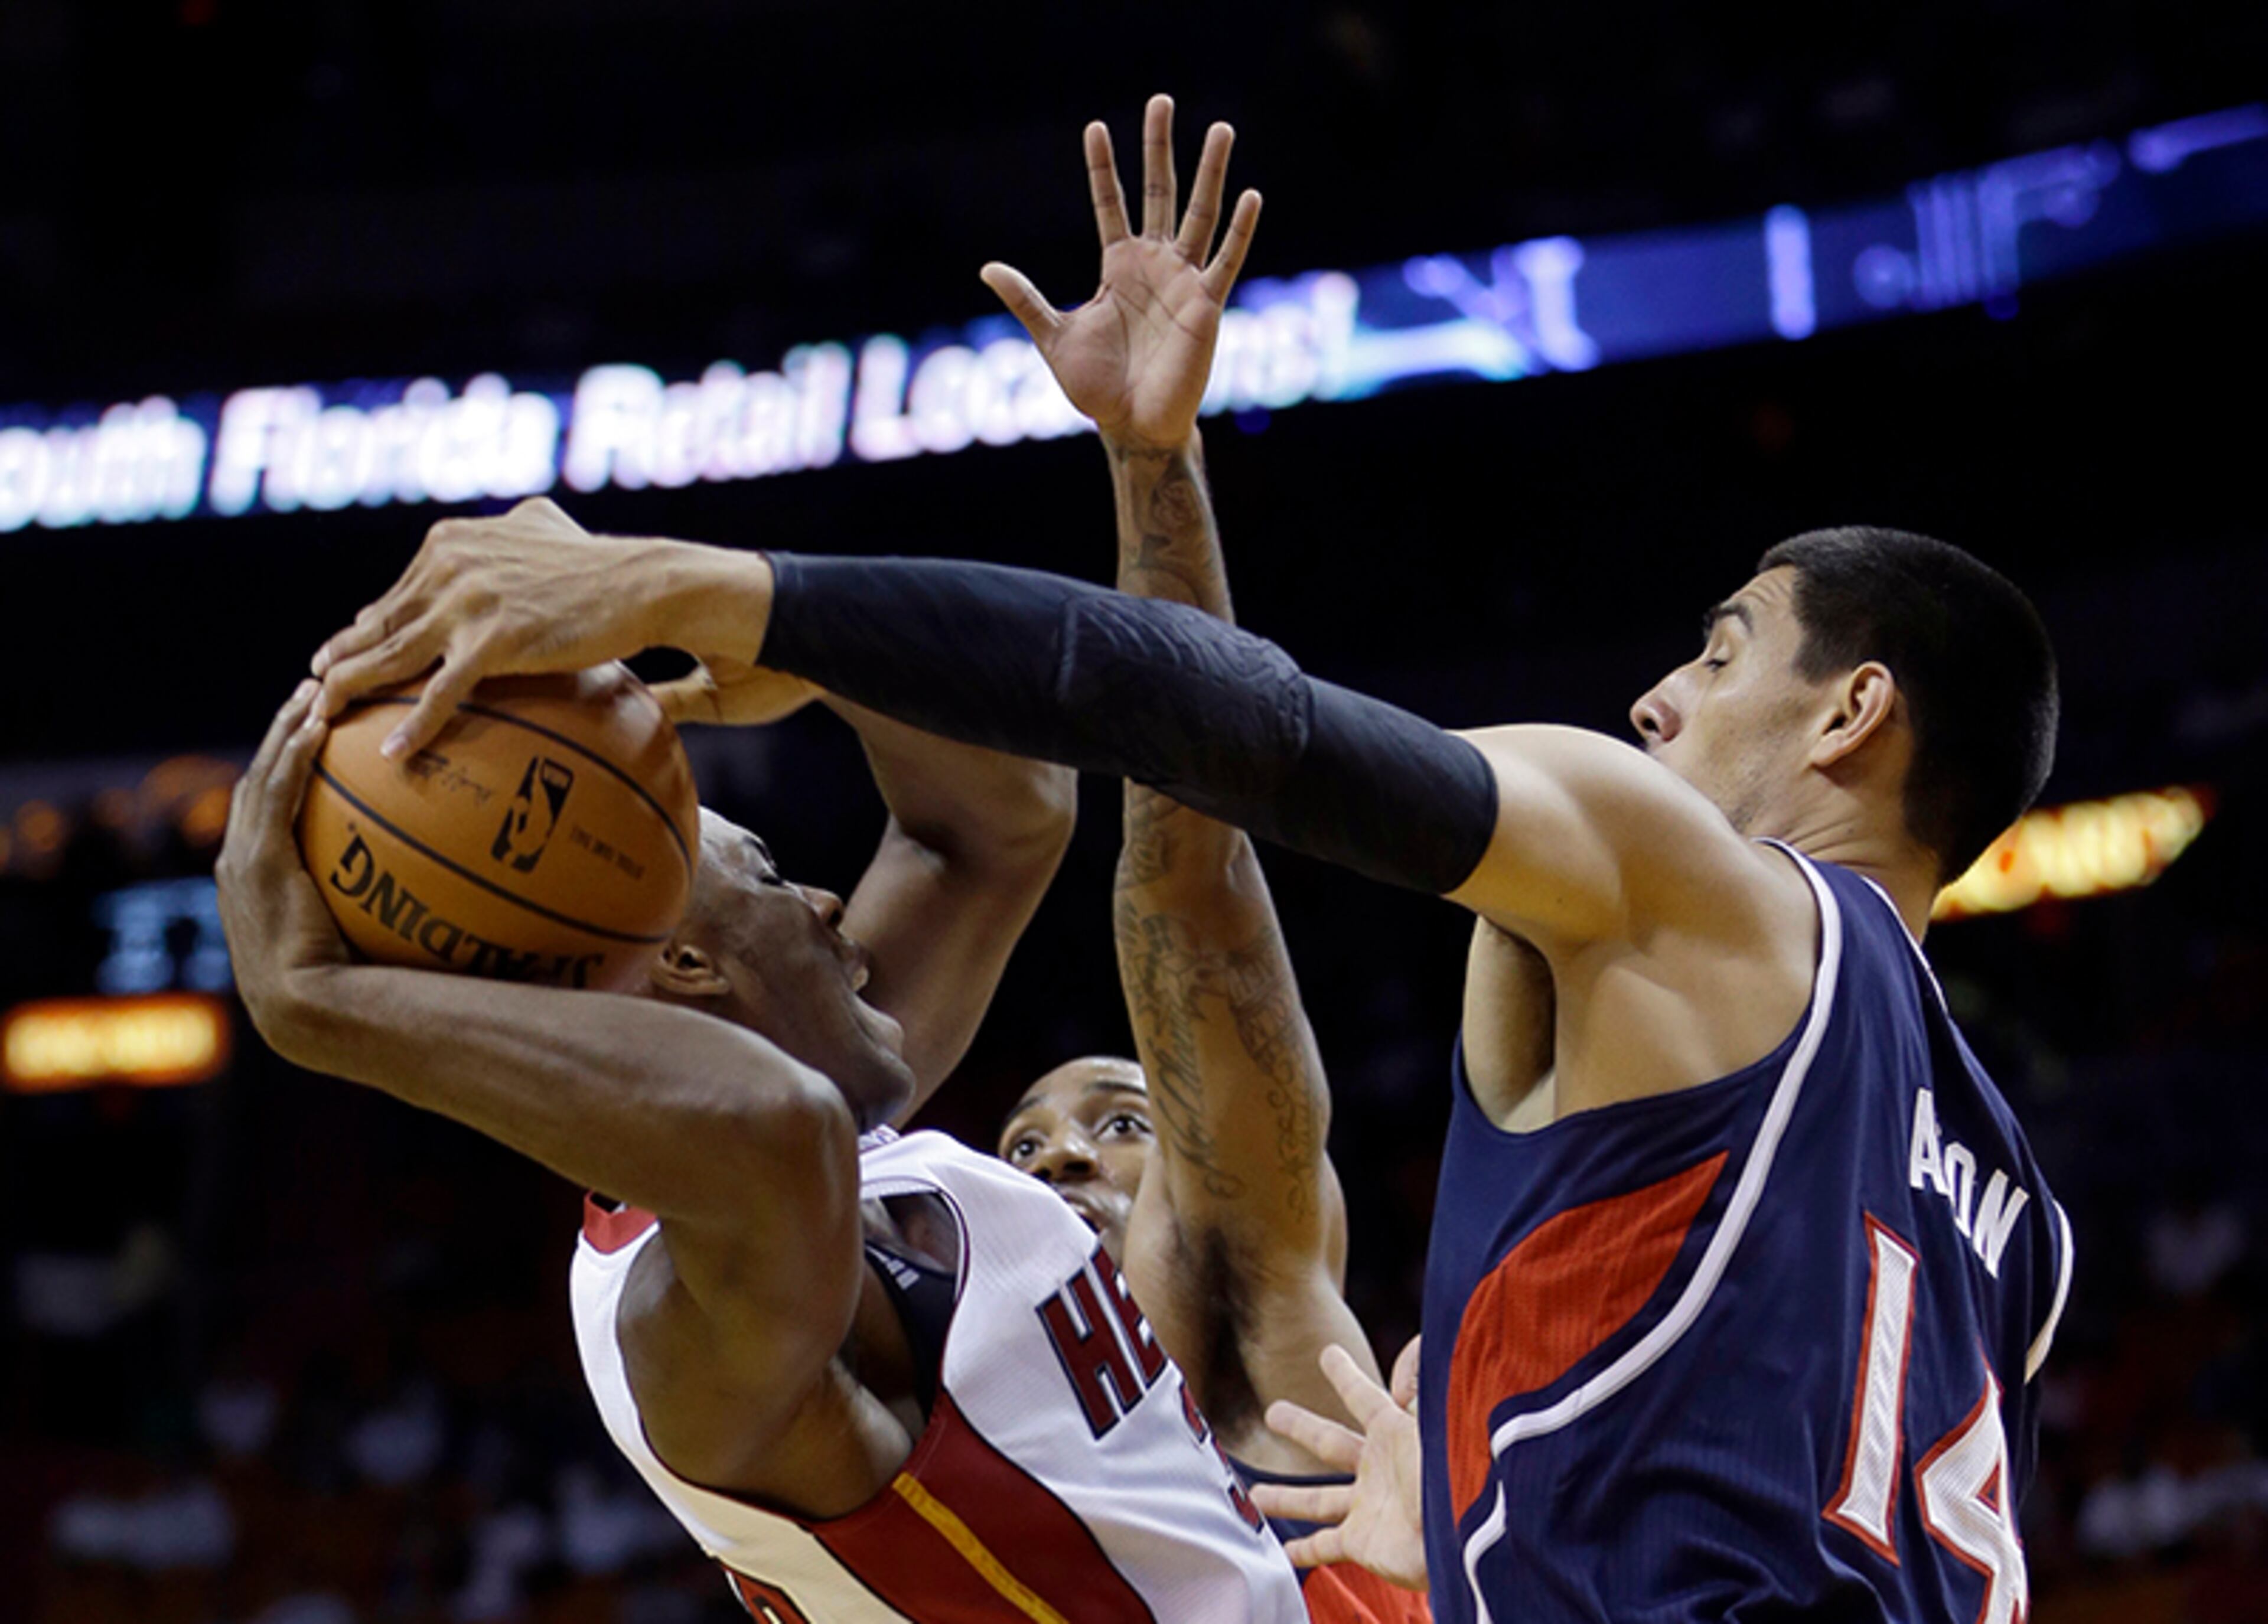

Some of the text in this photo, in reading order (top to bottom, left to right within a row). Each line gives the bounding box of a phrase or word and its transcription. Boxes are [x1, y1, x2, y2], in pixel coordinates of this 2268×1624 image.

[208, 372, 559, 517] Florida
[563, 341, 852, 493] Retail
[1909, 1088, 2029, 1279] AON
[1821, 1209, 2030, 1624] 14
